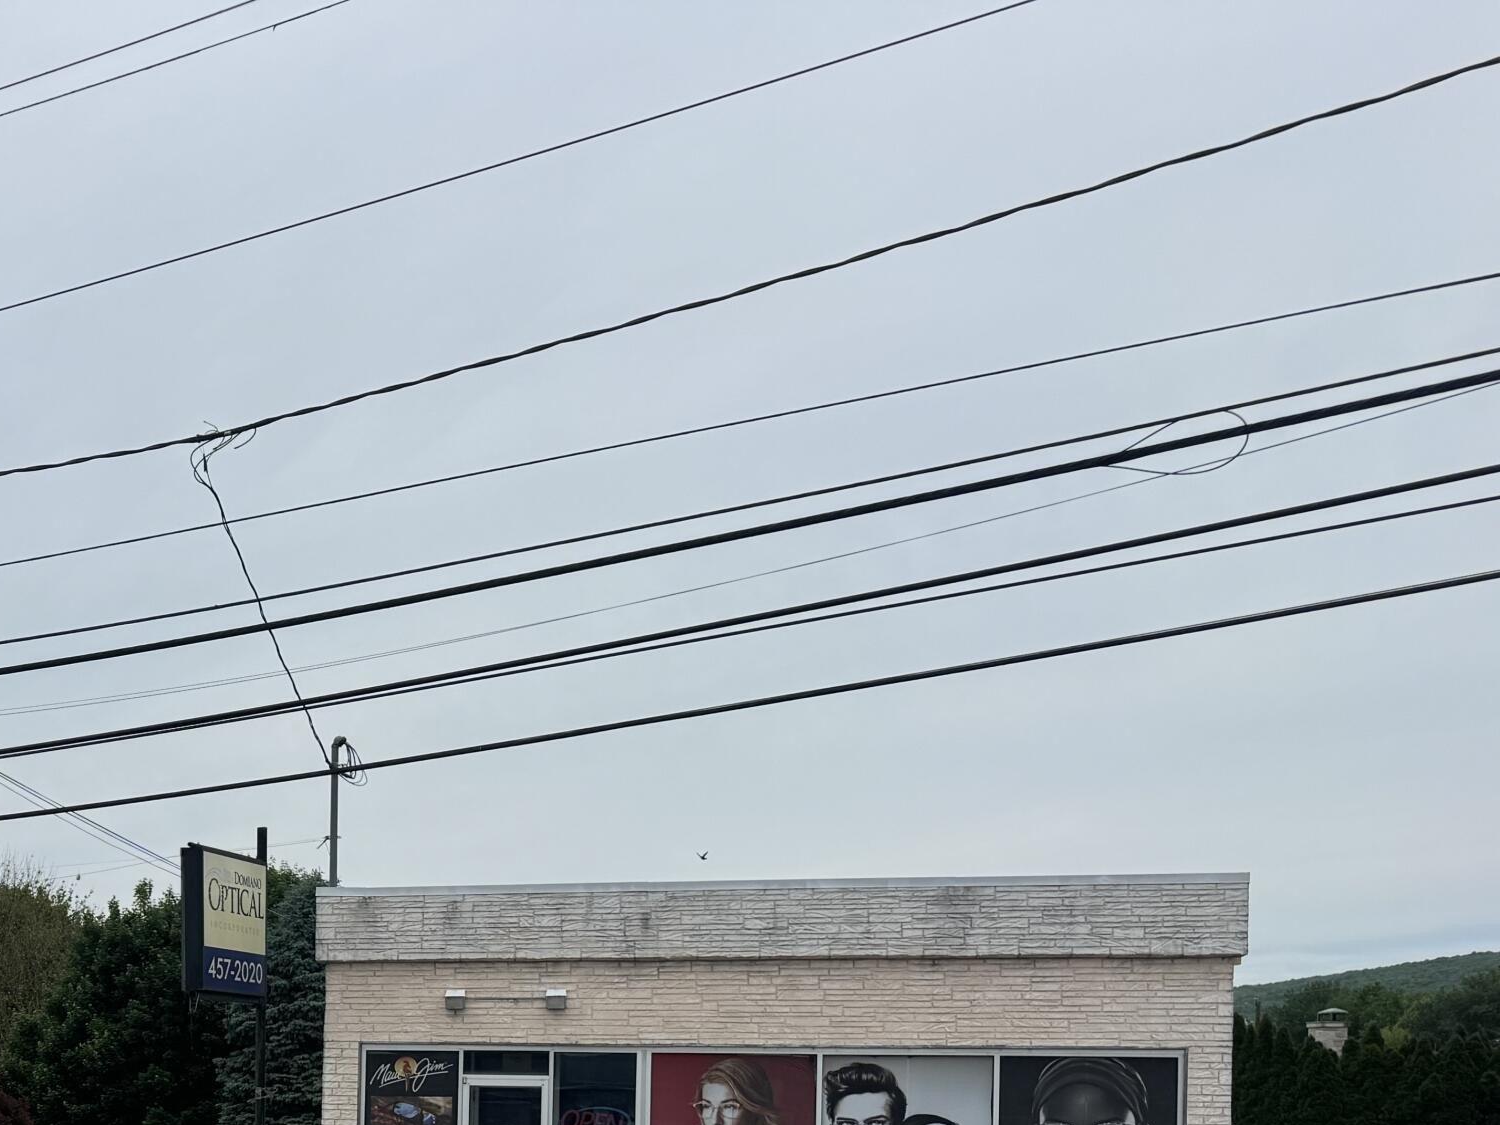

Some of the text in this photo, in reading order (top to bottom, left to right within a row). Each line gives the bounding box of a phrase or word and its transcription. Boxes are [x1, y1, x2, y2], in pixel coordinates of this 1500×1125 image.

[208, 877, 264, 920] OPTICAL
[208, 956, 263, 985] 457-2020
[412, 1057, 454, 1093] Jim
